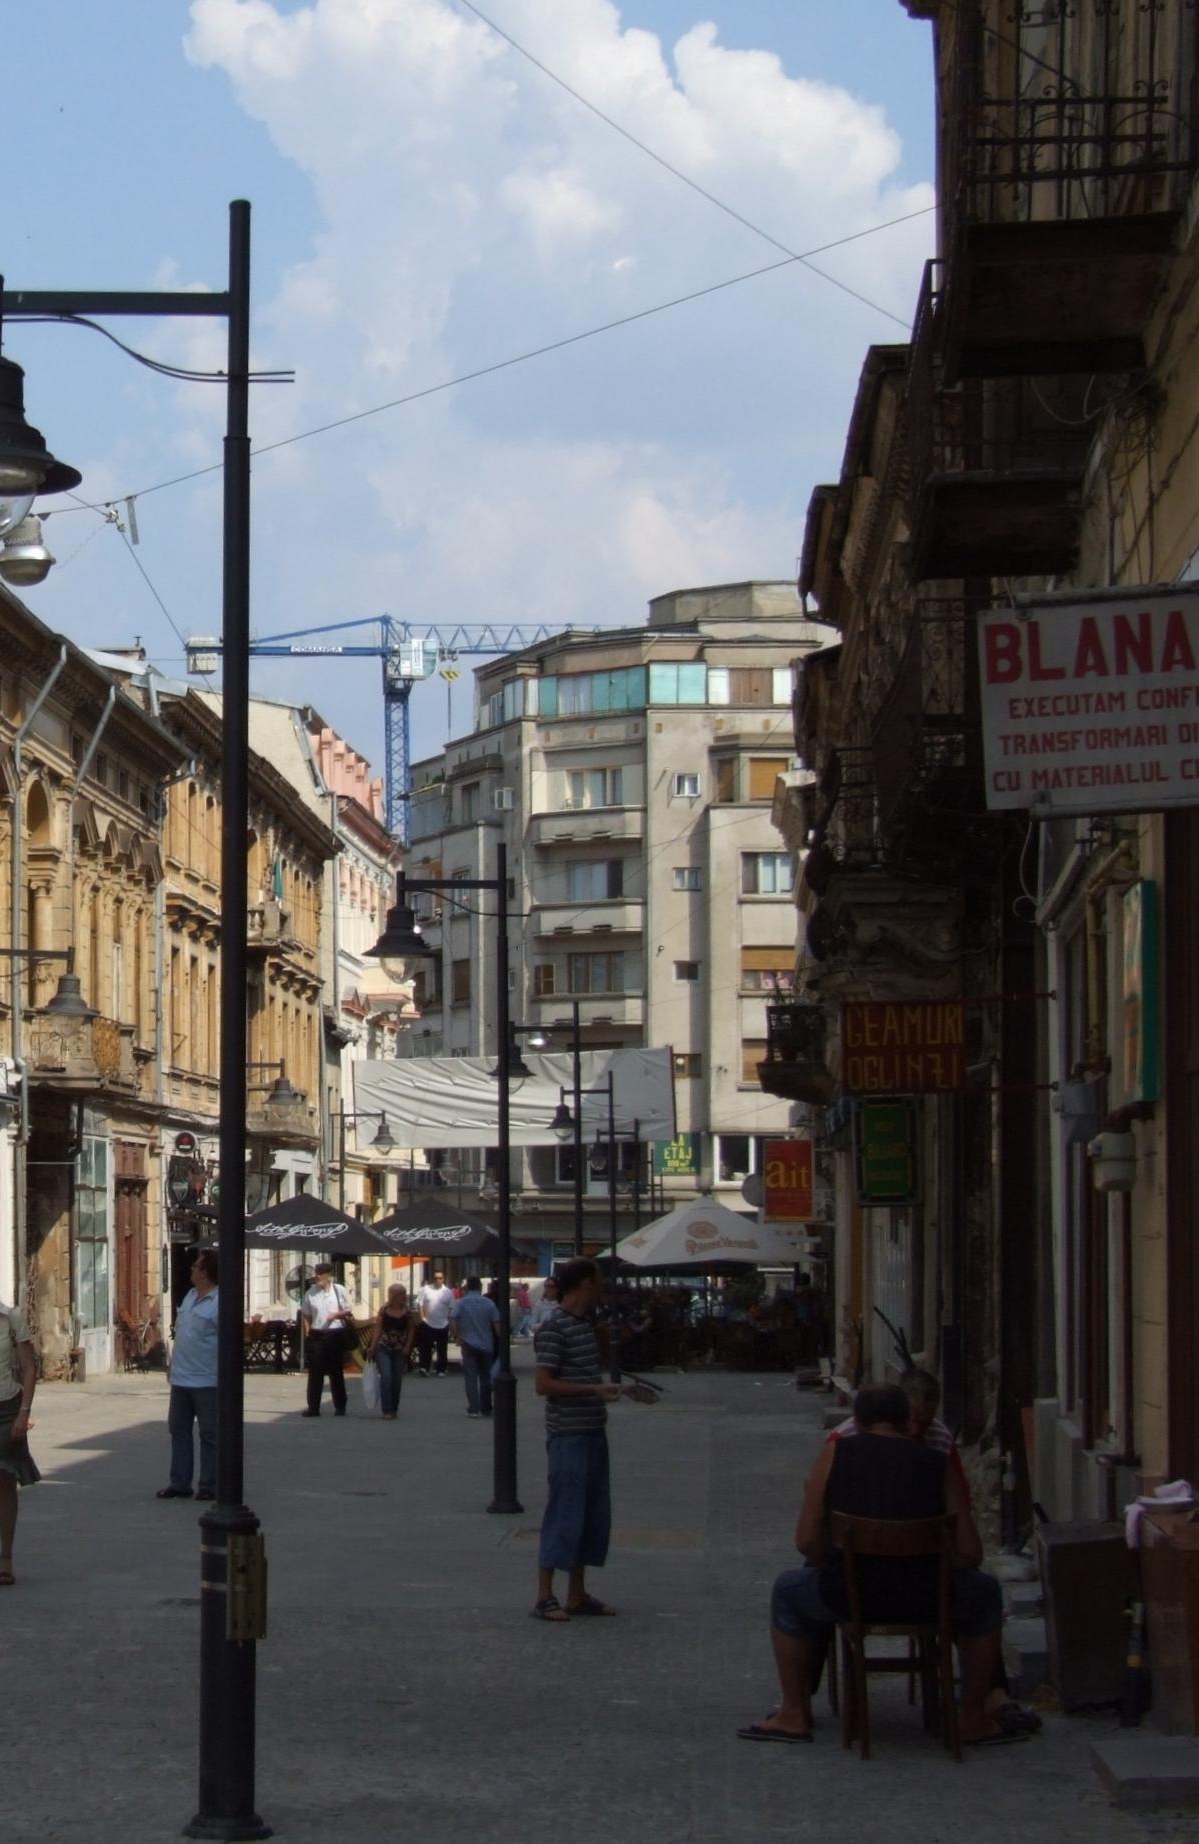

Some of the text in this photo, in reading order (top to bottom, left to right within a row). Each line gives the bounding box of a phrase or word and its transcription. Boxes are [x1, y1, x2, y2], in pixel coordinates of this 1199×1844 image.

[984, 610, 1196, 685] BLANA
[1009, 692, 1126, 719] EXECUTAM
[999, 724, 1168, 755] TRANSFORMARI
[993, 770, 1021, 793] CU
[1030, 761, 1169, 791] MATERIALUL
[846, 1003, 964, 1048] GEAMURI
[847, 1053, 962, 1089] OGLINZI
[664, 1147, 692, 1160] ETAJ
